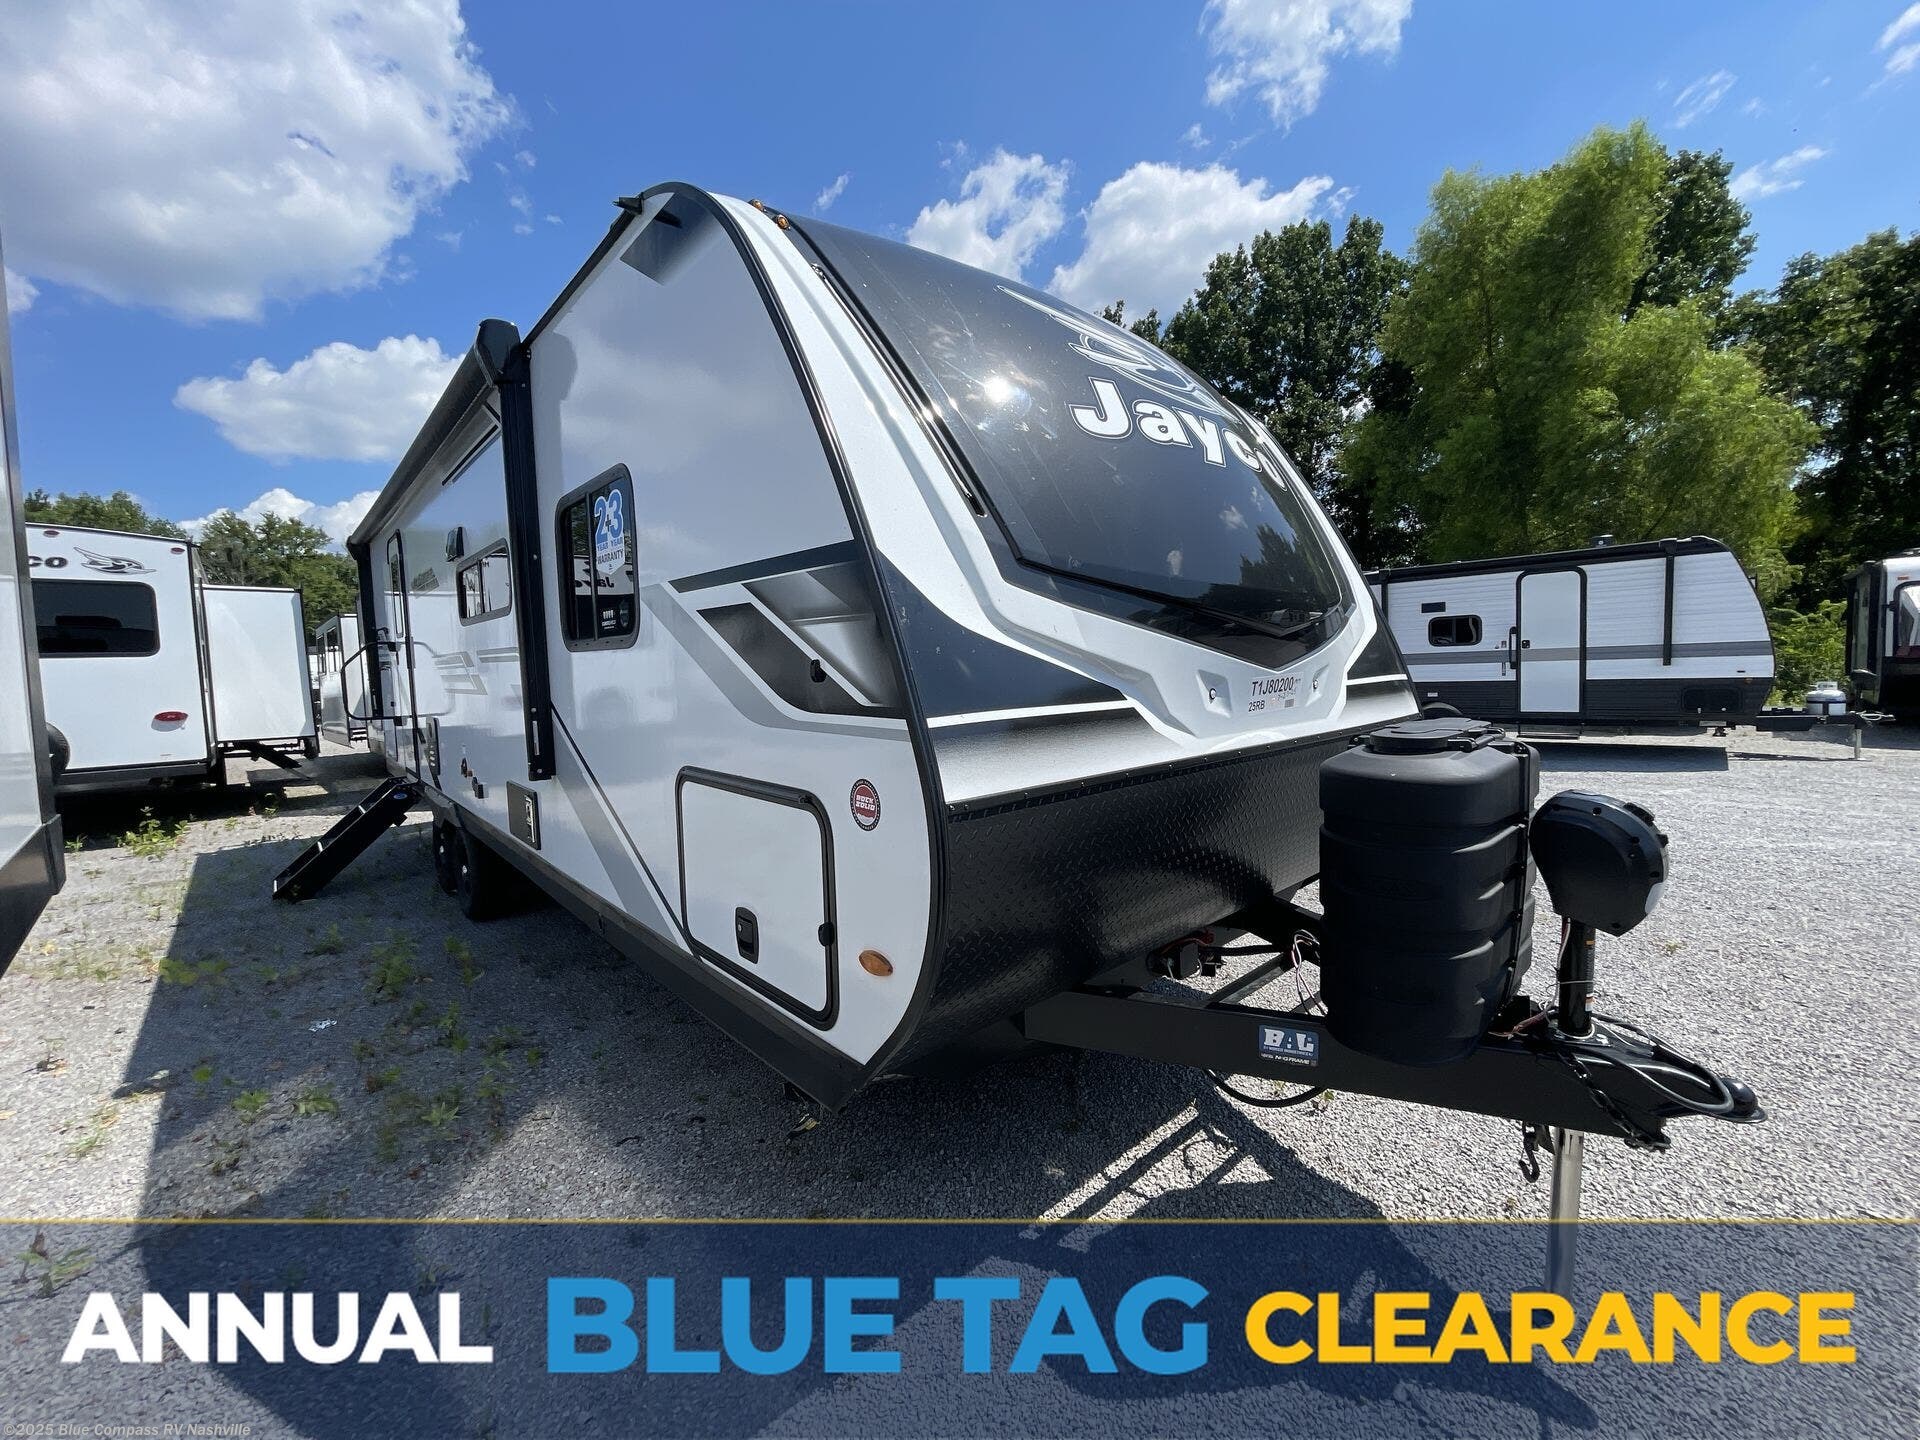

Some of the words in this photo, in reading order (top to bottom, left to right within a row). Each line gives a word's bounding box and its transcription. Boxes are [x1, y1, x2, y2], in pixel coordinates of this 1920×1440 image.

[1069, 377, 1287, 491] Jayco
[598, 548, 623, 564] WARRANTY
[855, 801, 875, 811] SOLID
[856, 794, 874, 804] ROCK
[1264, 1028, 1314, 1052] BAL
